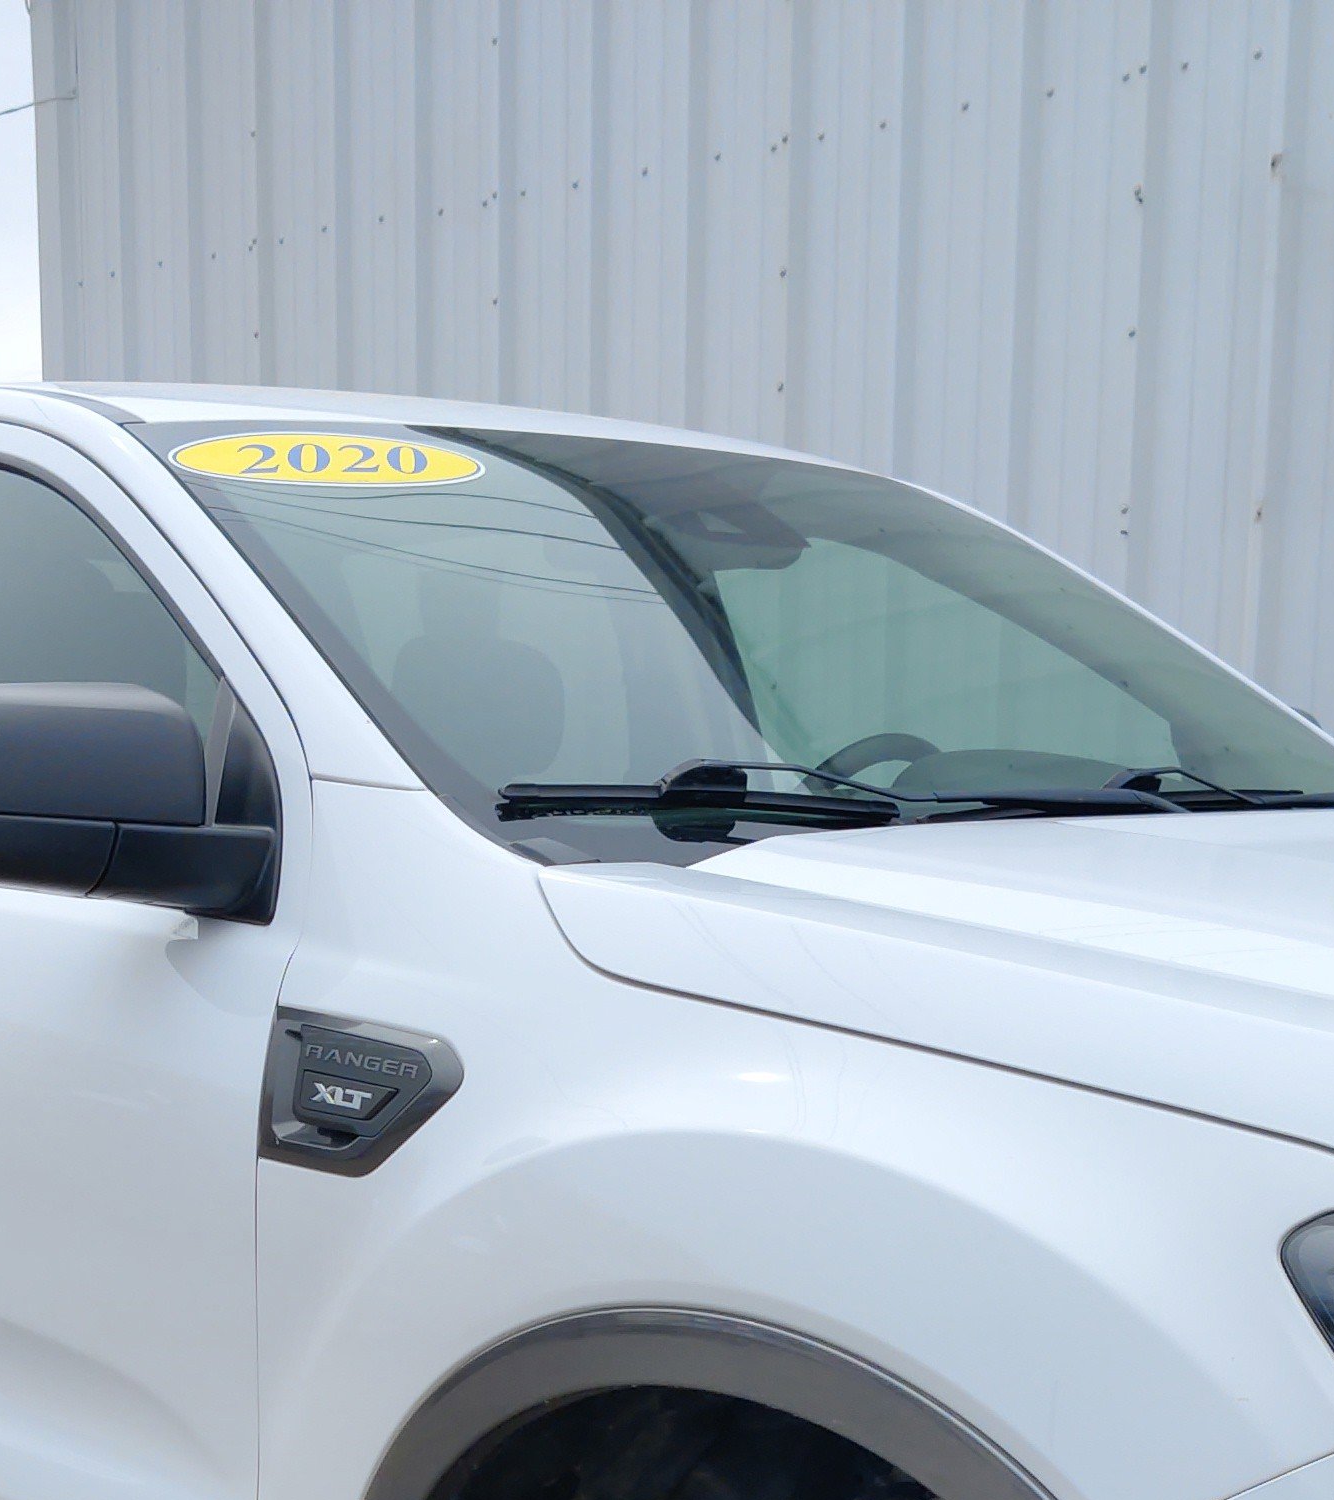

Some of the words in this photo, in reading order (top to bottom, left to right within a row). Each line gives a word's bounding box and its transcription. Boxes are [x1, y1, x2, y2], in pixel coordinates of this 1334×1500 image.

[237, 442, 428, 474] 2020
[305, 1044, 419, 1079] RANGER
[310, 1082, 372, 1110] XLT
